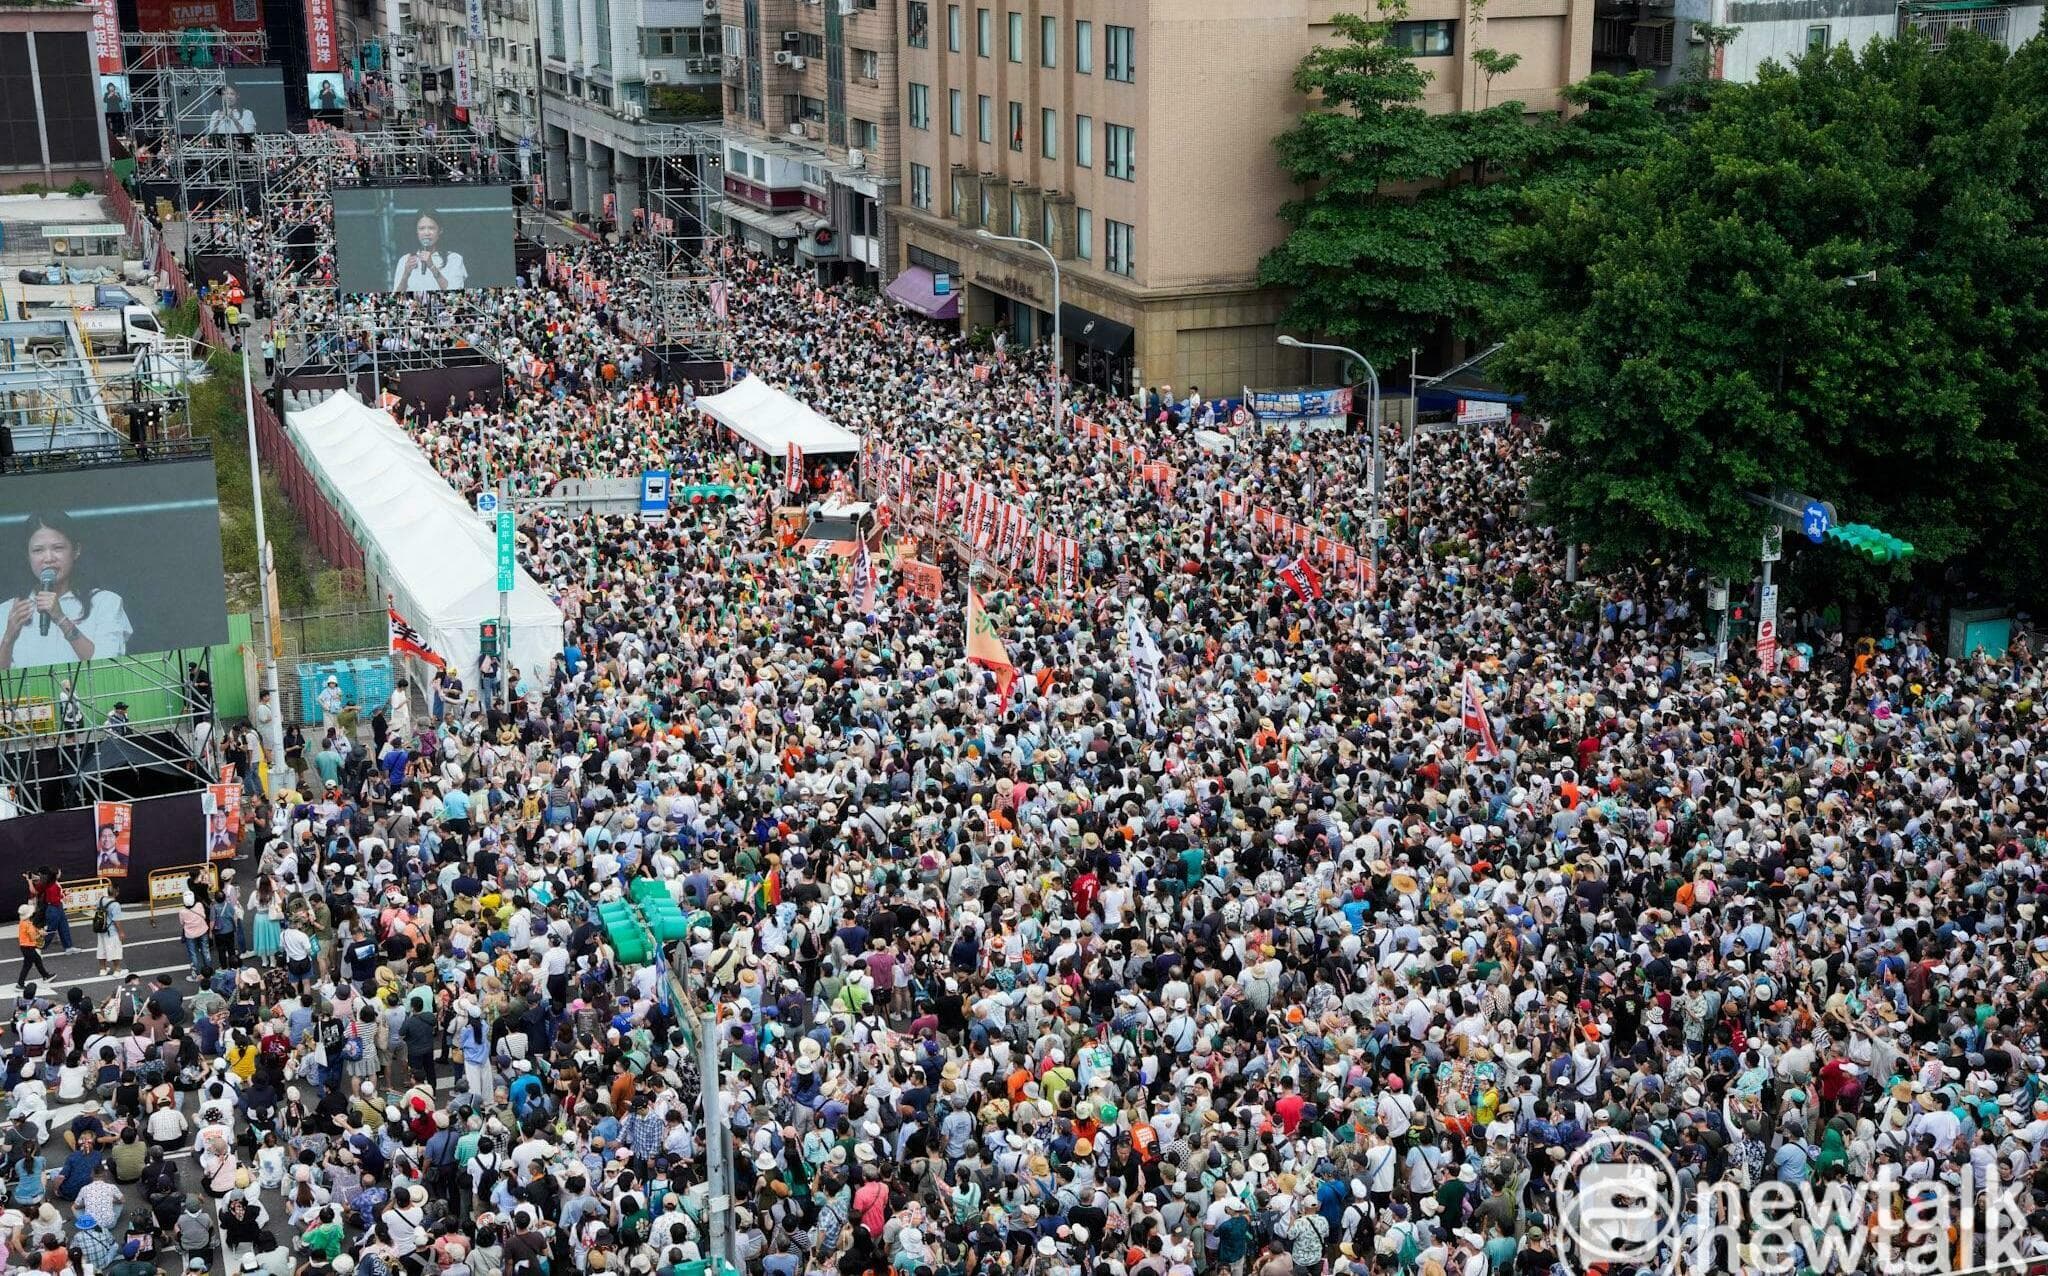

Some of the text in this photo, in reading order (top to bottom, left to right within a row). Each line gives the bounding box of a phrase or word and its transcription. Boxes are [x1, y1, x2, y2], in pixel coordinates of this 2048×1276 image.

[172, 4, 217, 18] TAIPEI
[106, 17, 118, 58] FUTURE
[313, 17, 331, 64] 沈伯洋
[501, 520, 511, 565] 北平東路
